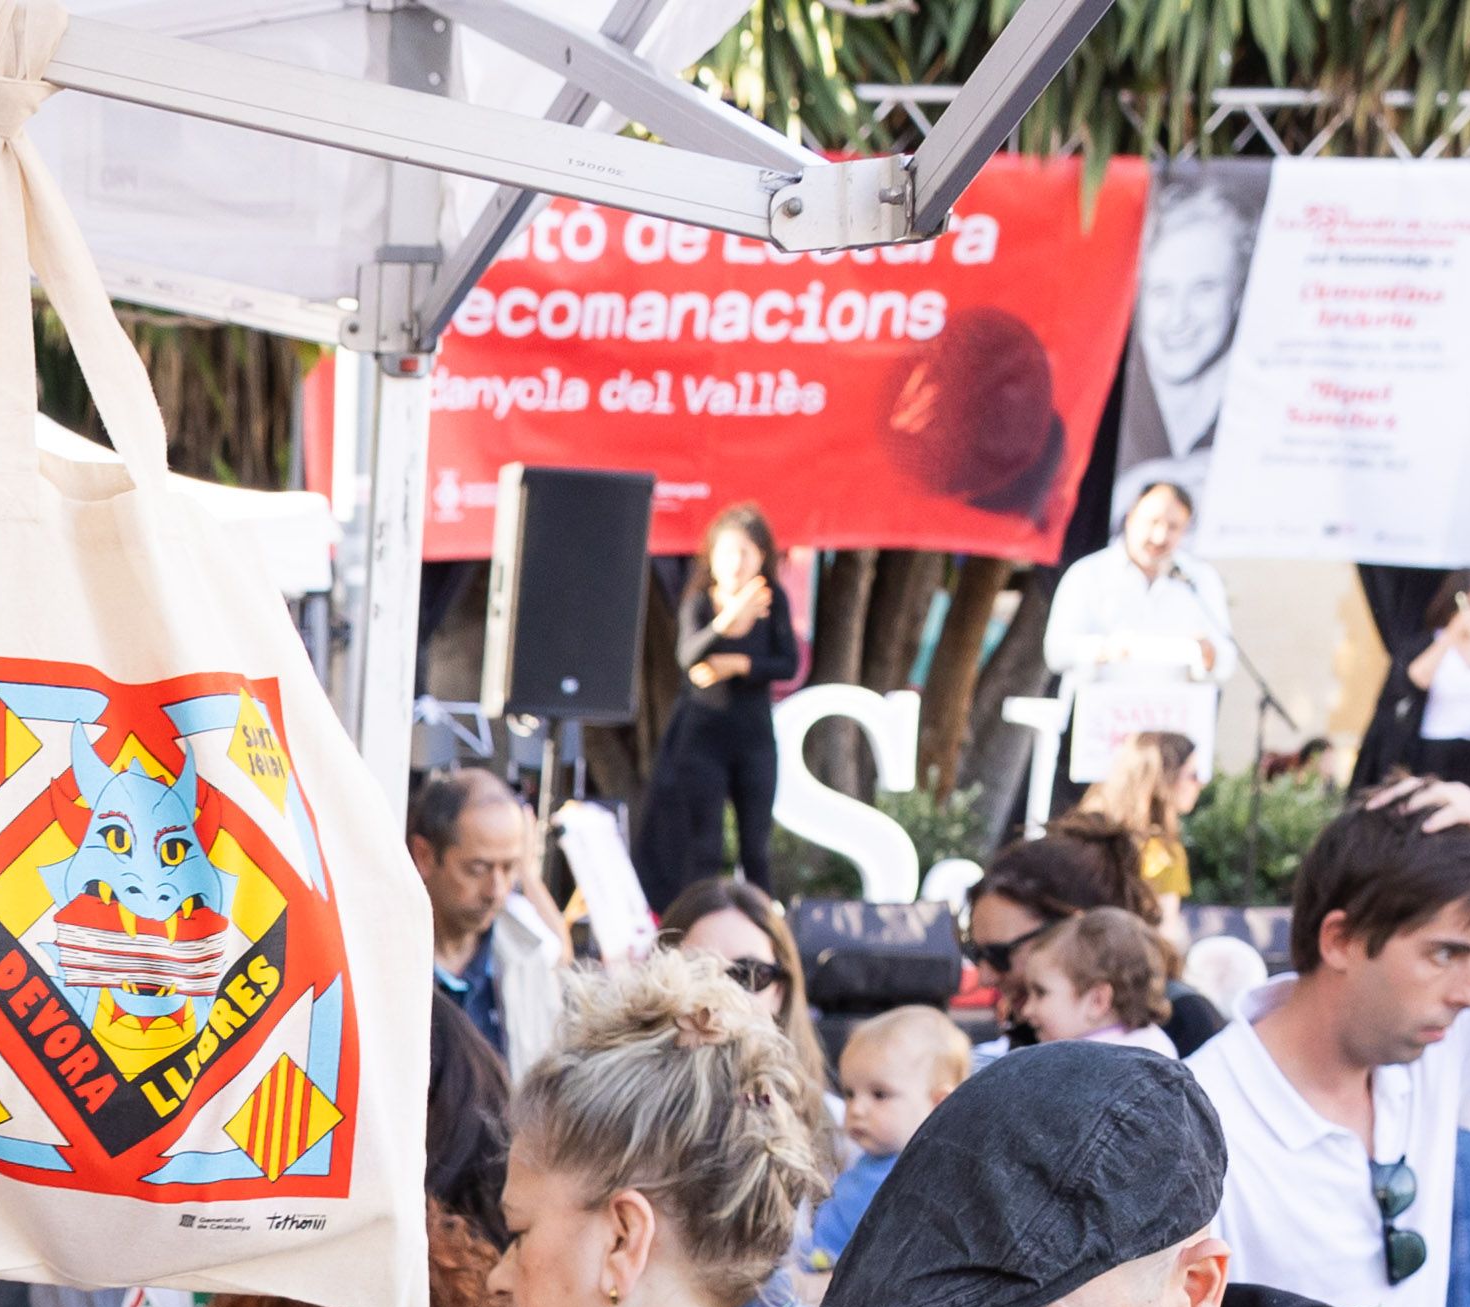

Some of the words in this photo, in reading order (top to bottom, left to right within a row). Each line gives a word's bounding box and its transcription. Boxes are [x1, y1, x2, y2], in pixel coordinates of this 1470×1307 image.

[443, 282, 948, 344] ecomanacions
[599, 370, 676, 415] del
[683, 368, 827, 417] Vallès
[140, 955, 283, 1119] LLIBRES
